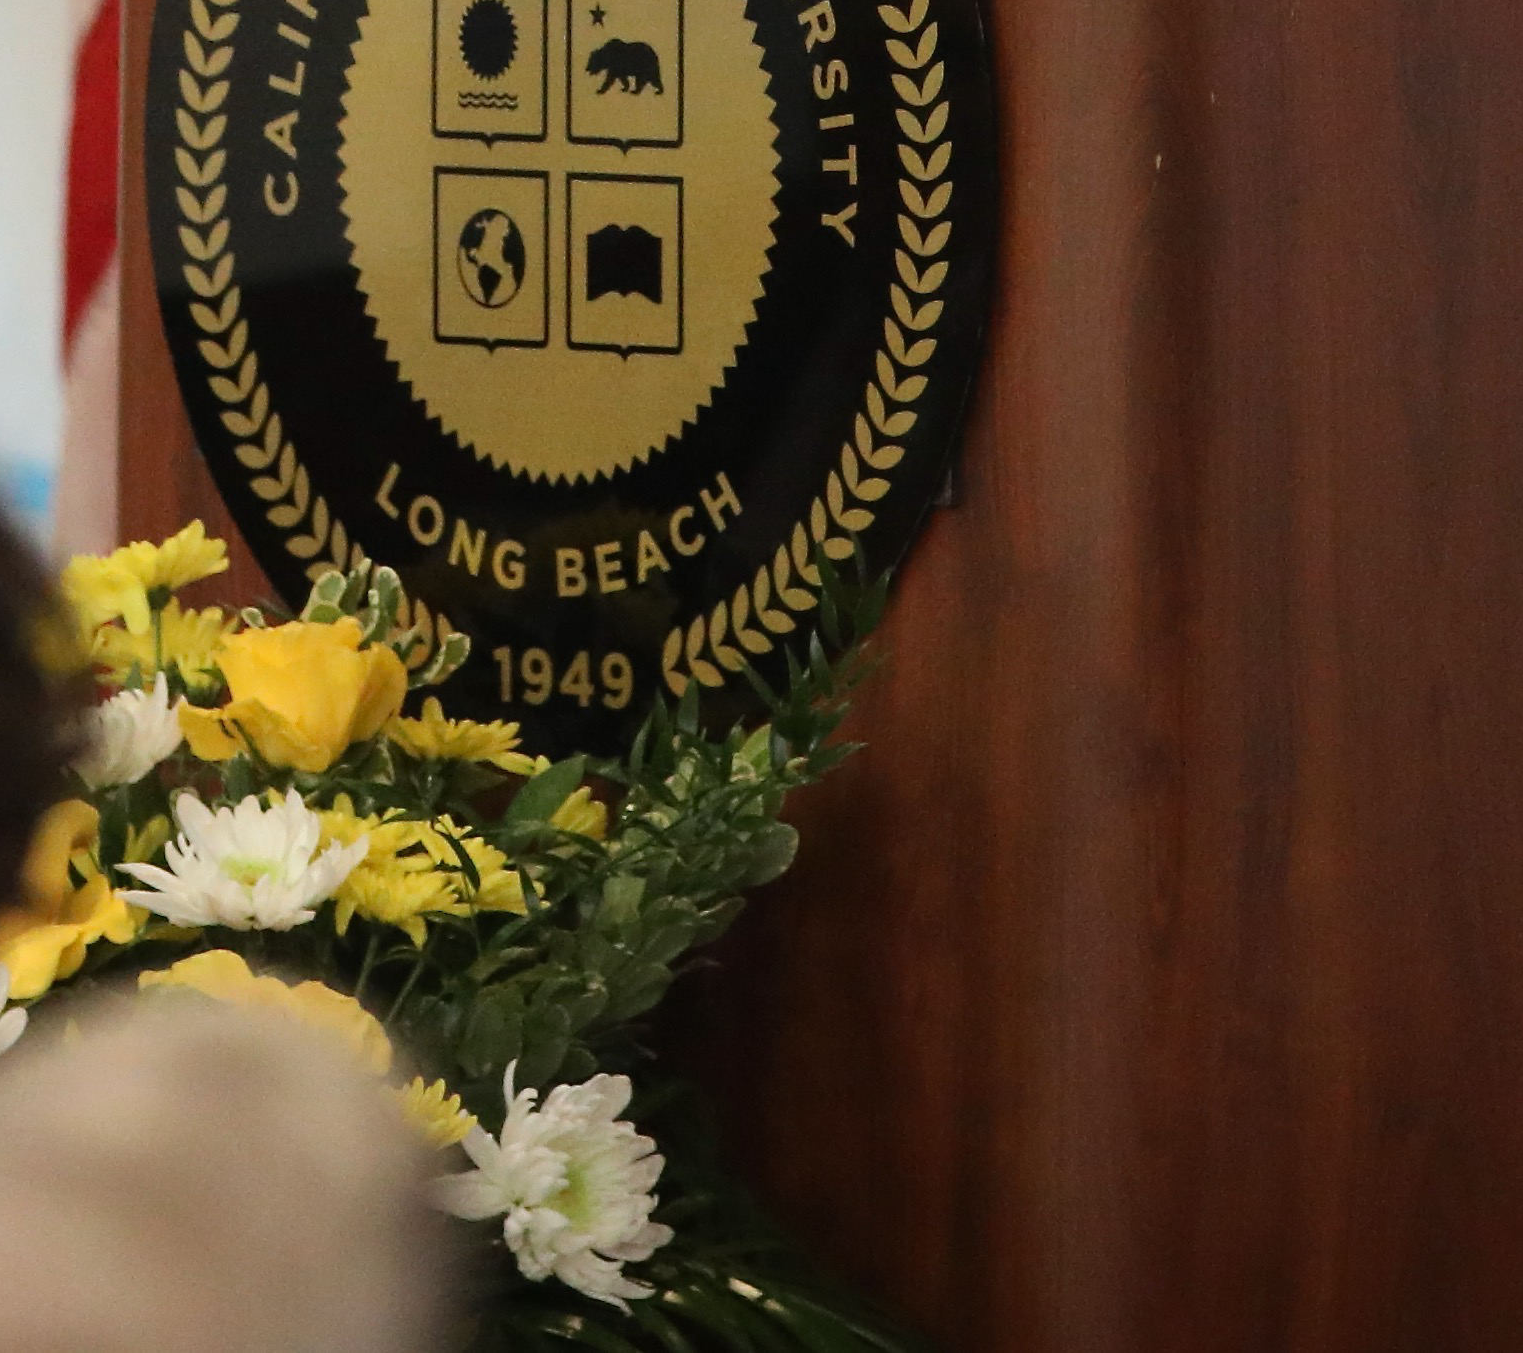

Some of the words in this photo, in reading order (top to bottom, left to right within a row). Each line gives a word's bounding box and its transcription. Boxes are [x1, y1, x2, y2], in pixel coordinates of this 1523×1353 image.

[375, 462, 527, 591] LONG
[556, 471, 744, 598] BEACH
[491, 645, 634, 710] 1949
